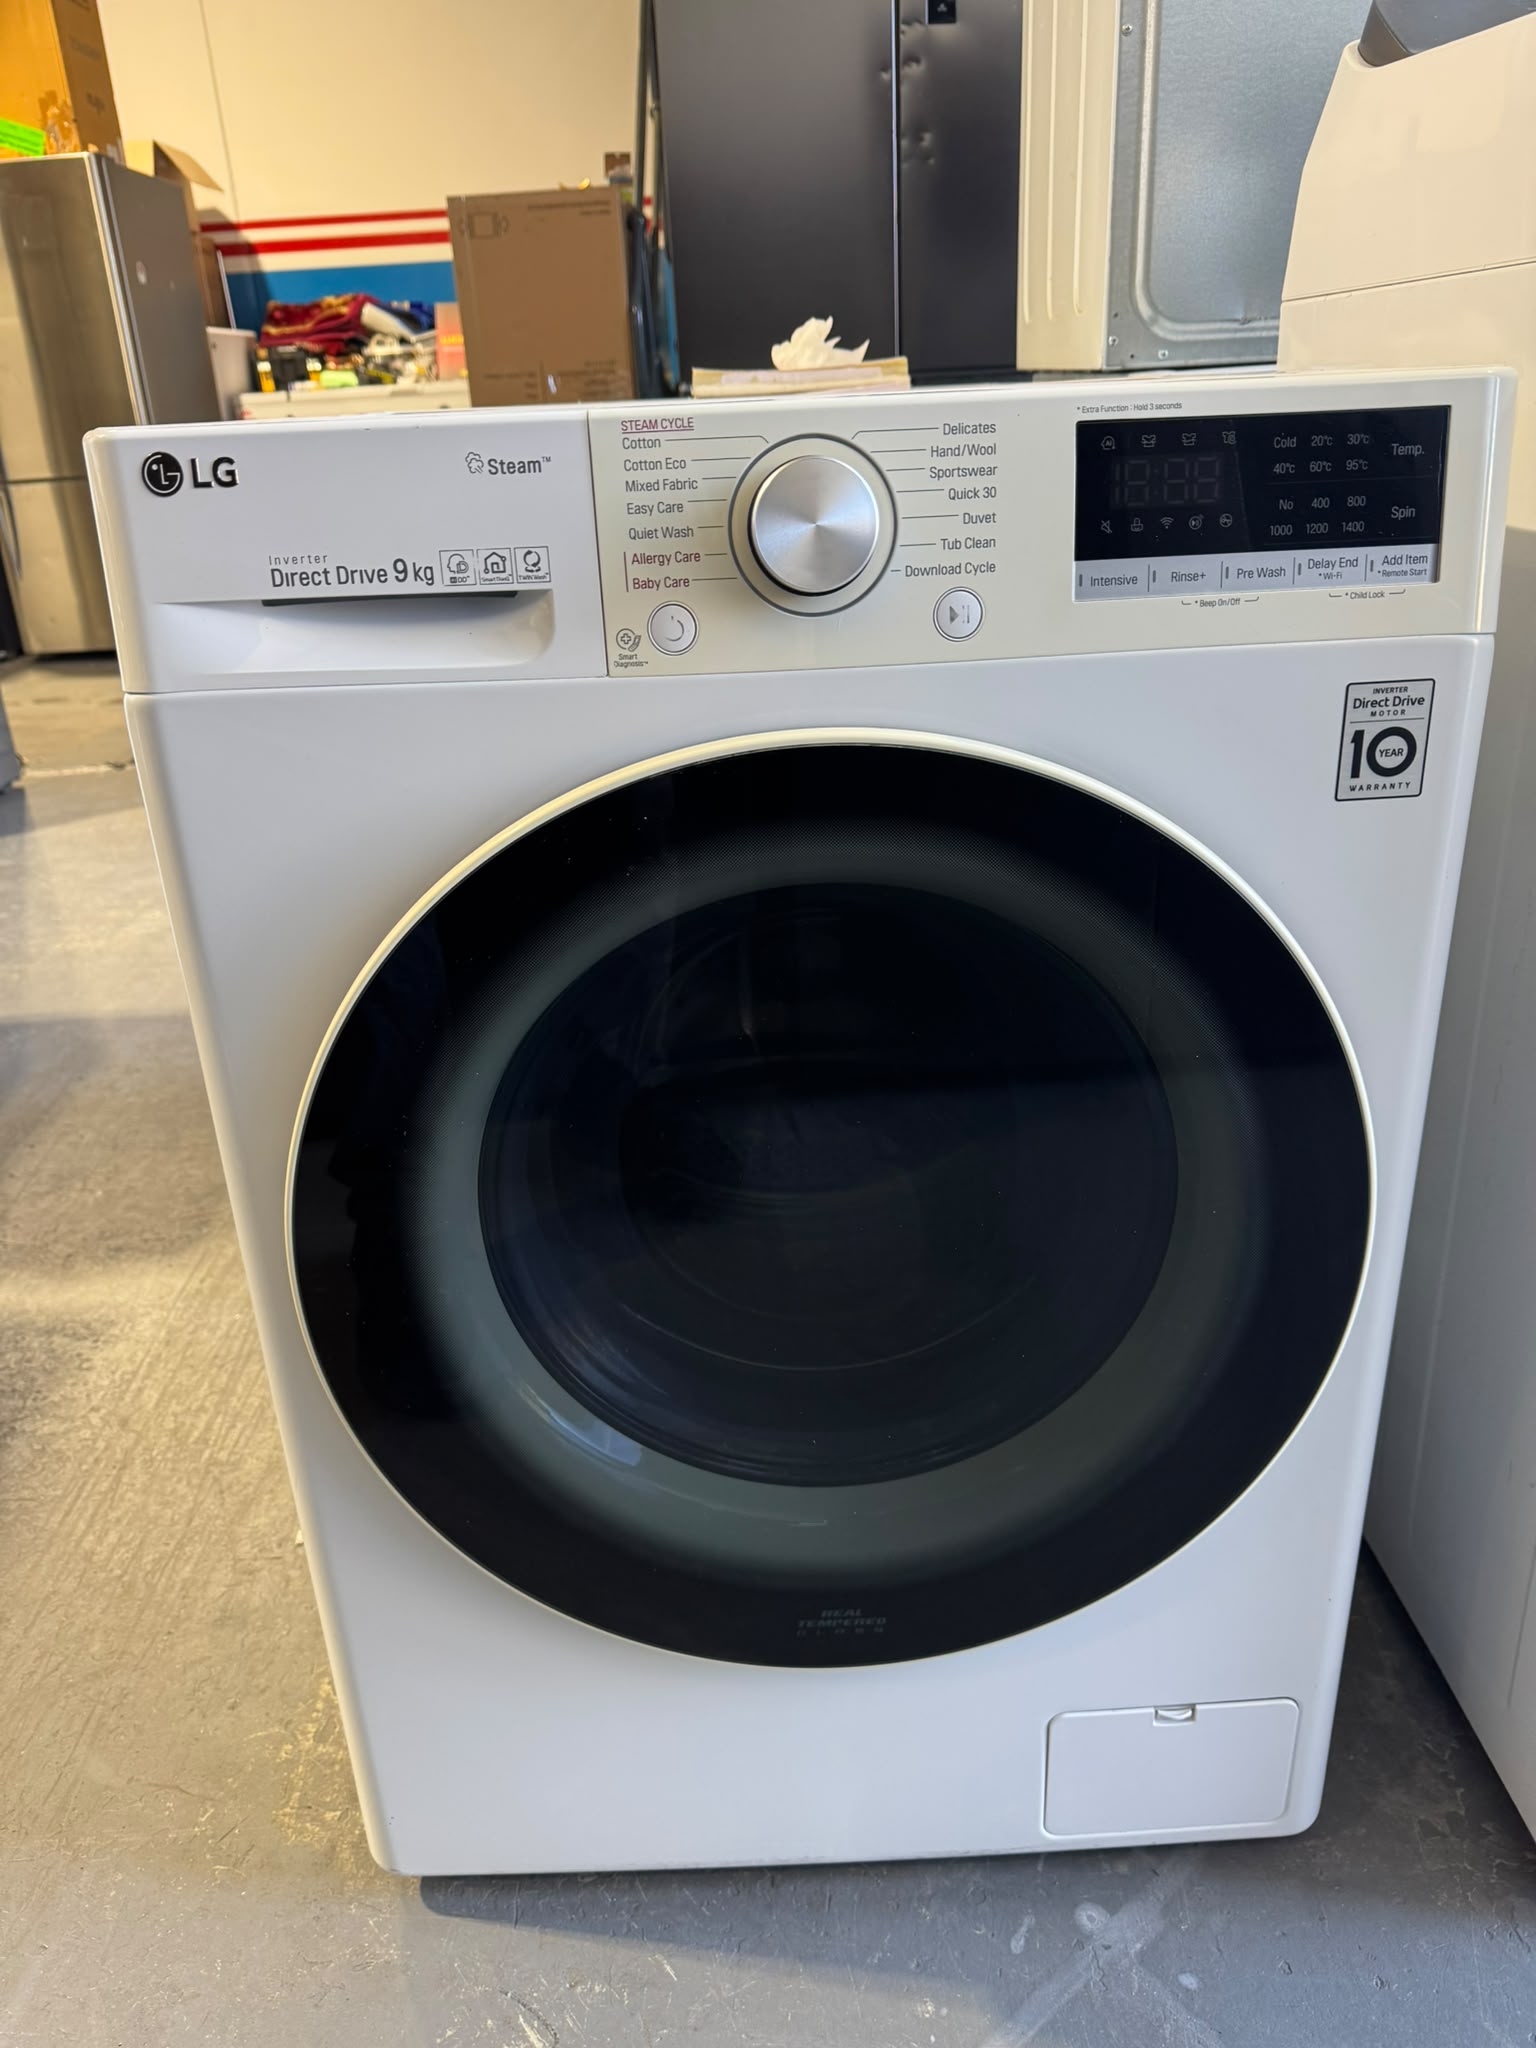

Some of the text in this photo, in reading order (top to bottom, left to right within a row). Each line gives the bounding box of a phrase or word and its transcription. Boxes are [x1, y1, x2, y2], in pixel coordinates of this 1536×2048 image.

[1081, 399, 1182, 414] Extra Function Hold 3 seconds
[621, 417, 694, 431] STEAM CYCLE
[943, 422, 997, 436] Delicates
[622, 437, 661, 450] Cotton
[1273, 436, 1297, 449] Cold
[930, 442, 997, 458] Hand/Wool
[1391, 443, 1425, 457] Temp.
[623, 457, 687, 472] Cotton Eco
[189, 456, 239, 489] LG
[929, 465, 998, 481] Sportswear
[625, 477, 699, 492] Mixed Fabric
[948, 486, 997, 500] Quick 30
[626, 501, 684, 516] Easy Care
[1279, 495, 1366, 510] No 400 800
[962, 512, 997, 524] Duvet
[1391, 505, 1416, 520] Spin
[628, 526, 694, 540] Quiet Wash
[1269, 520, 1365, 536] 1000 1200 1400
[940, 537, 996, 550] Tub Clean
[268, 554, 328, 566] Inverter
[631, 550, 701, 567] Allergy Care
[1307, 556, 1359, 570] Delay End
[1381, 554, 1428, 566] Add Item
[271, 558, 434, 587] Direct Drive 9 kg
[904, 561, 997, 577] Download Cycle
[1236, 565, 1287, 579] Pre Wash
[1381, 568, 1428, 577] Remote Start
[1090, 574, 1138, 587] Intensive
[1170, 570, 1206, 583] Rinse+
[632, 576, 690, 592] Baby Care
[1349, 590, 1386, 599] Child Lock
[1199, 597, 1241, 608] Beep On/Off
[1372, 686, 1409, 694] INVERTER
[1352, 695, 1426, 709] Direct Drive
[1370, 709, 1406, 717] MOTOR
[1350, 726, 1417, 779] 10
[1378, 748, 1405, 758] YEAR
[1349, 782, 1412, 792] WARRANTY
